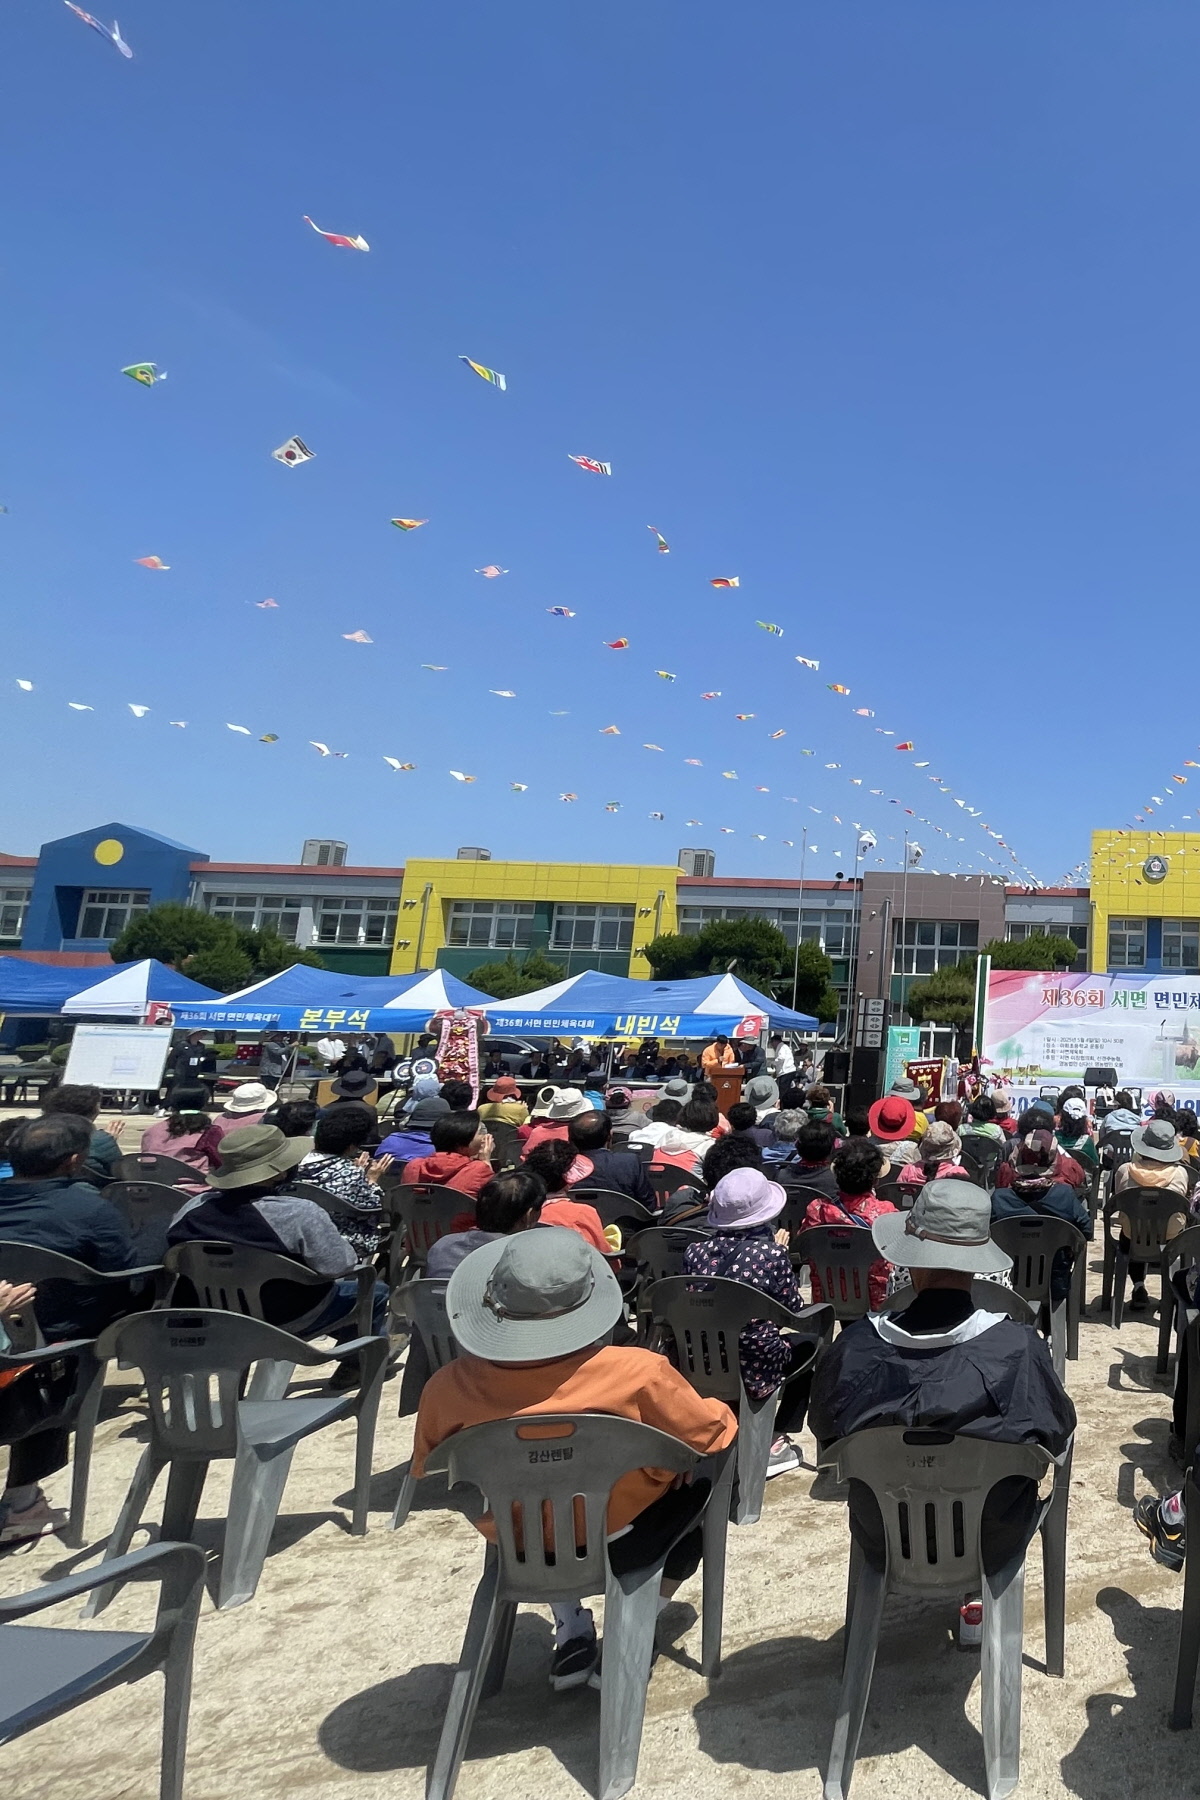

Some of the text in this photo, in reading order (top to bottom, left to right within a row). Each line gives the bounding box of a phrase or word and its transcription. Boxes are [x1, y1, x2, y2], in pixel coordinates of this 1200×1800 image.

[1041, 988, 1104, 1009] 제36회
[1110, 990, 1147, 1009] 서면
[208, 1012, 226, 1021] 서면
[227, 1012, 281, 1022] 면민체육대회
[299, 1008, 371, 1031] 본부석
[495, 1018, 595, 1029] 제36회 서면 면민체육대회
[614, 1014, 681, 1035] 내빈석
[742, 1019, 757, 1032] 승
[528, 1447, 574, 1464] 강산렌탈
